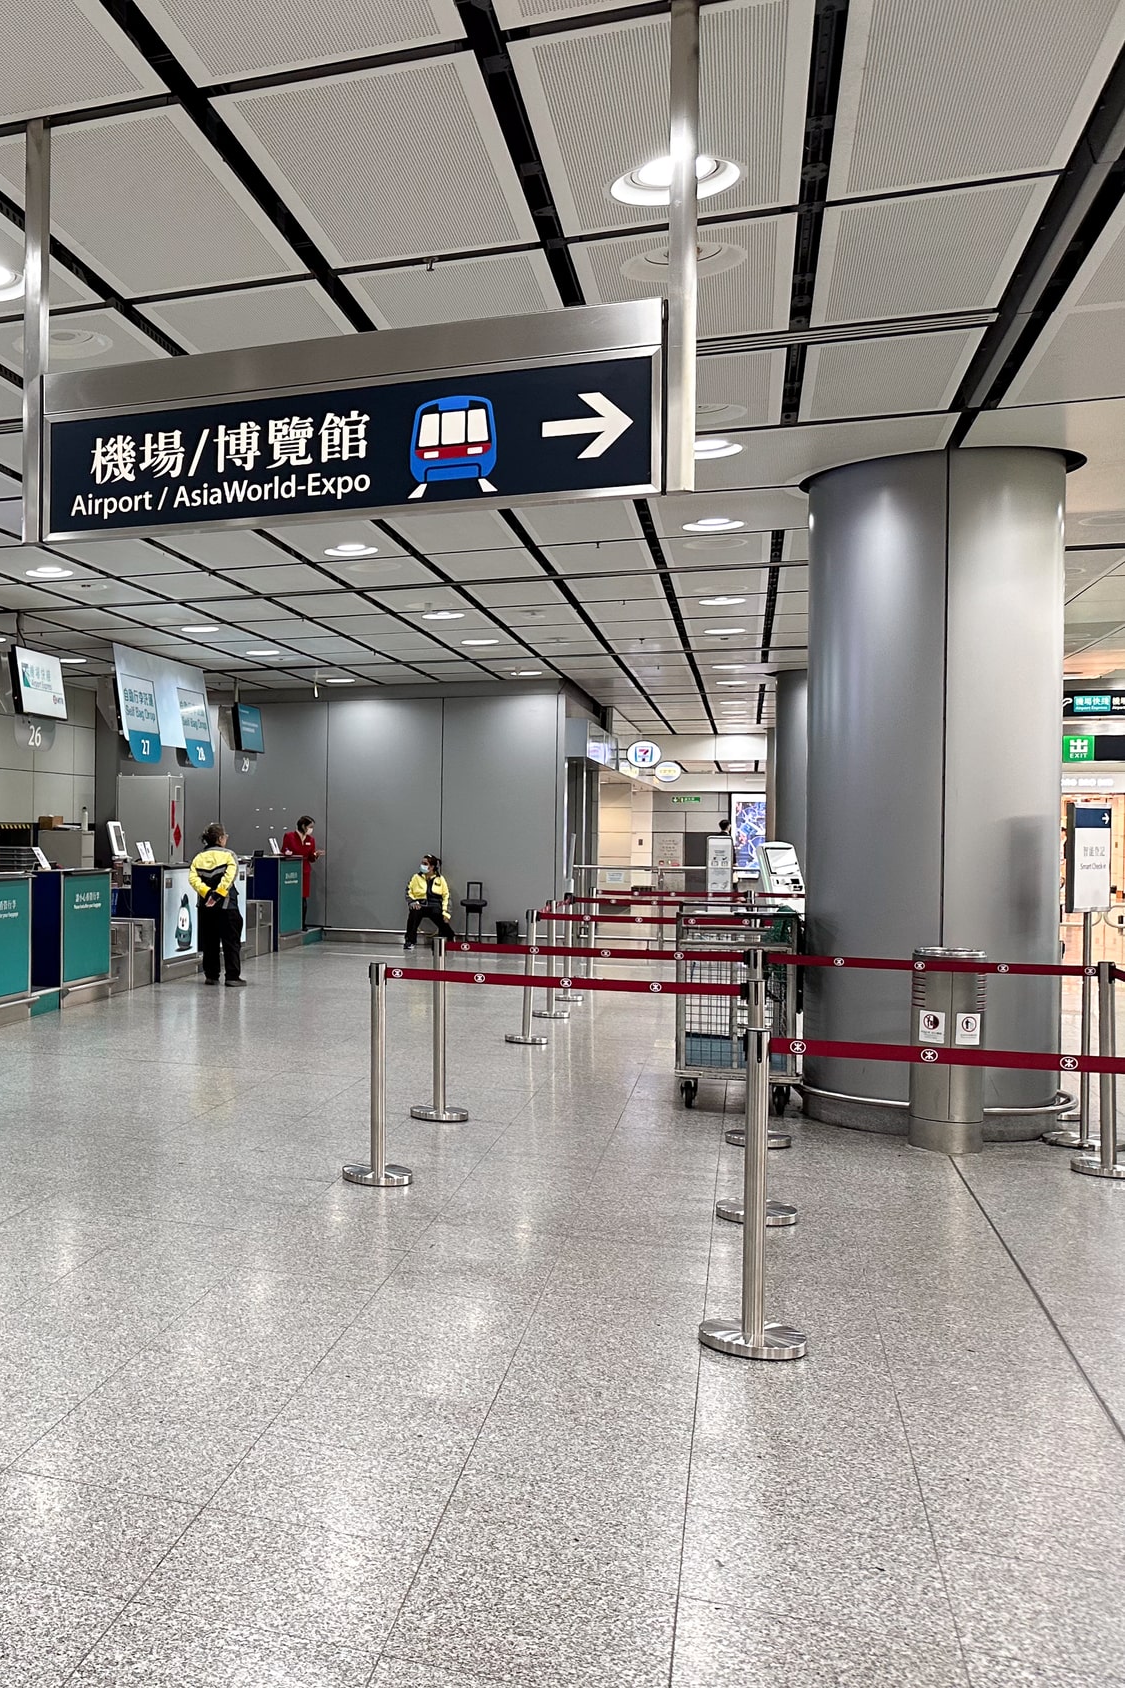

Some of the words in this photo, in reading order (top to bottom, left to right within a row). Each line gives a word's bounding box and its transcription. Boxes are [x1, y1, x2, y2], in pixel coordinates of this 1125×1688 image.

[90, 410, 370, 485] 機場/博覽館
[71, 490, 153, 520] Airport
[157, 487, 168, 511] /
[173, 473, 371, 508] AsiaWorld-Expo
[125, 704, 135, 717] Self
[135, 707, 145, 721] Bag
[144, 708, 156, 723] Drop
[28, 725, 41, 747] 26
[1069, 739, 1088, 753] 出
[141, 739, 150, 755] 27
